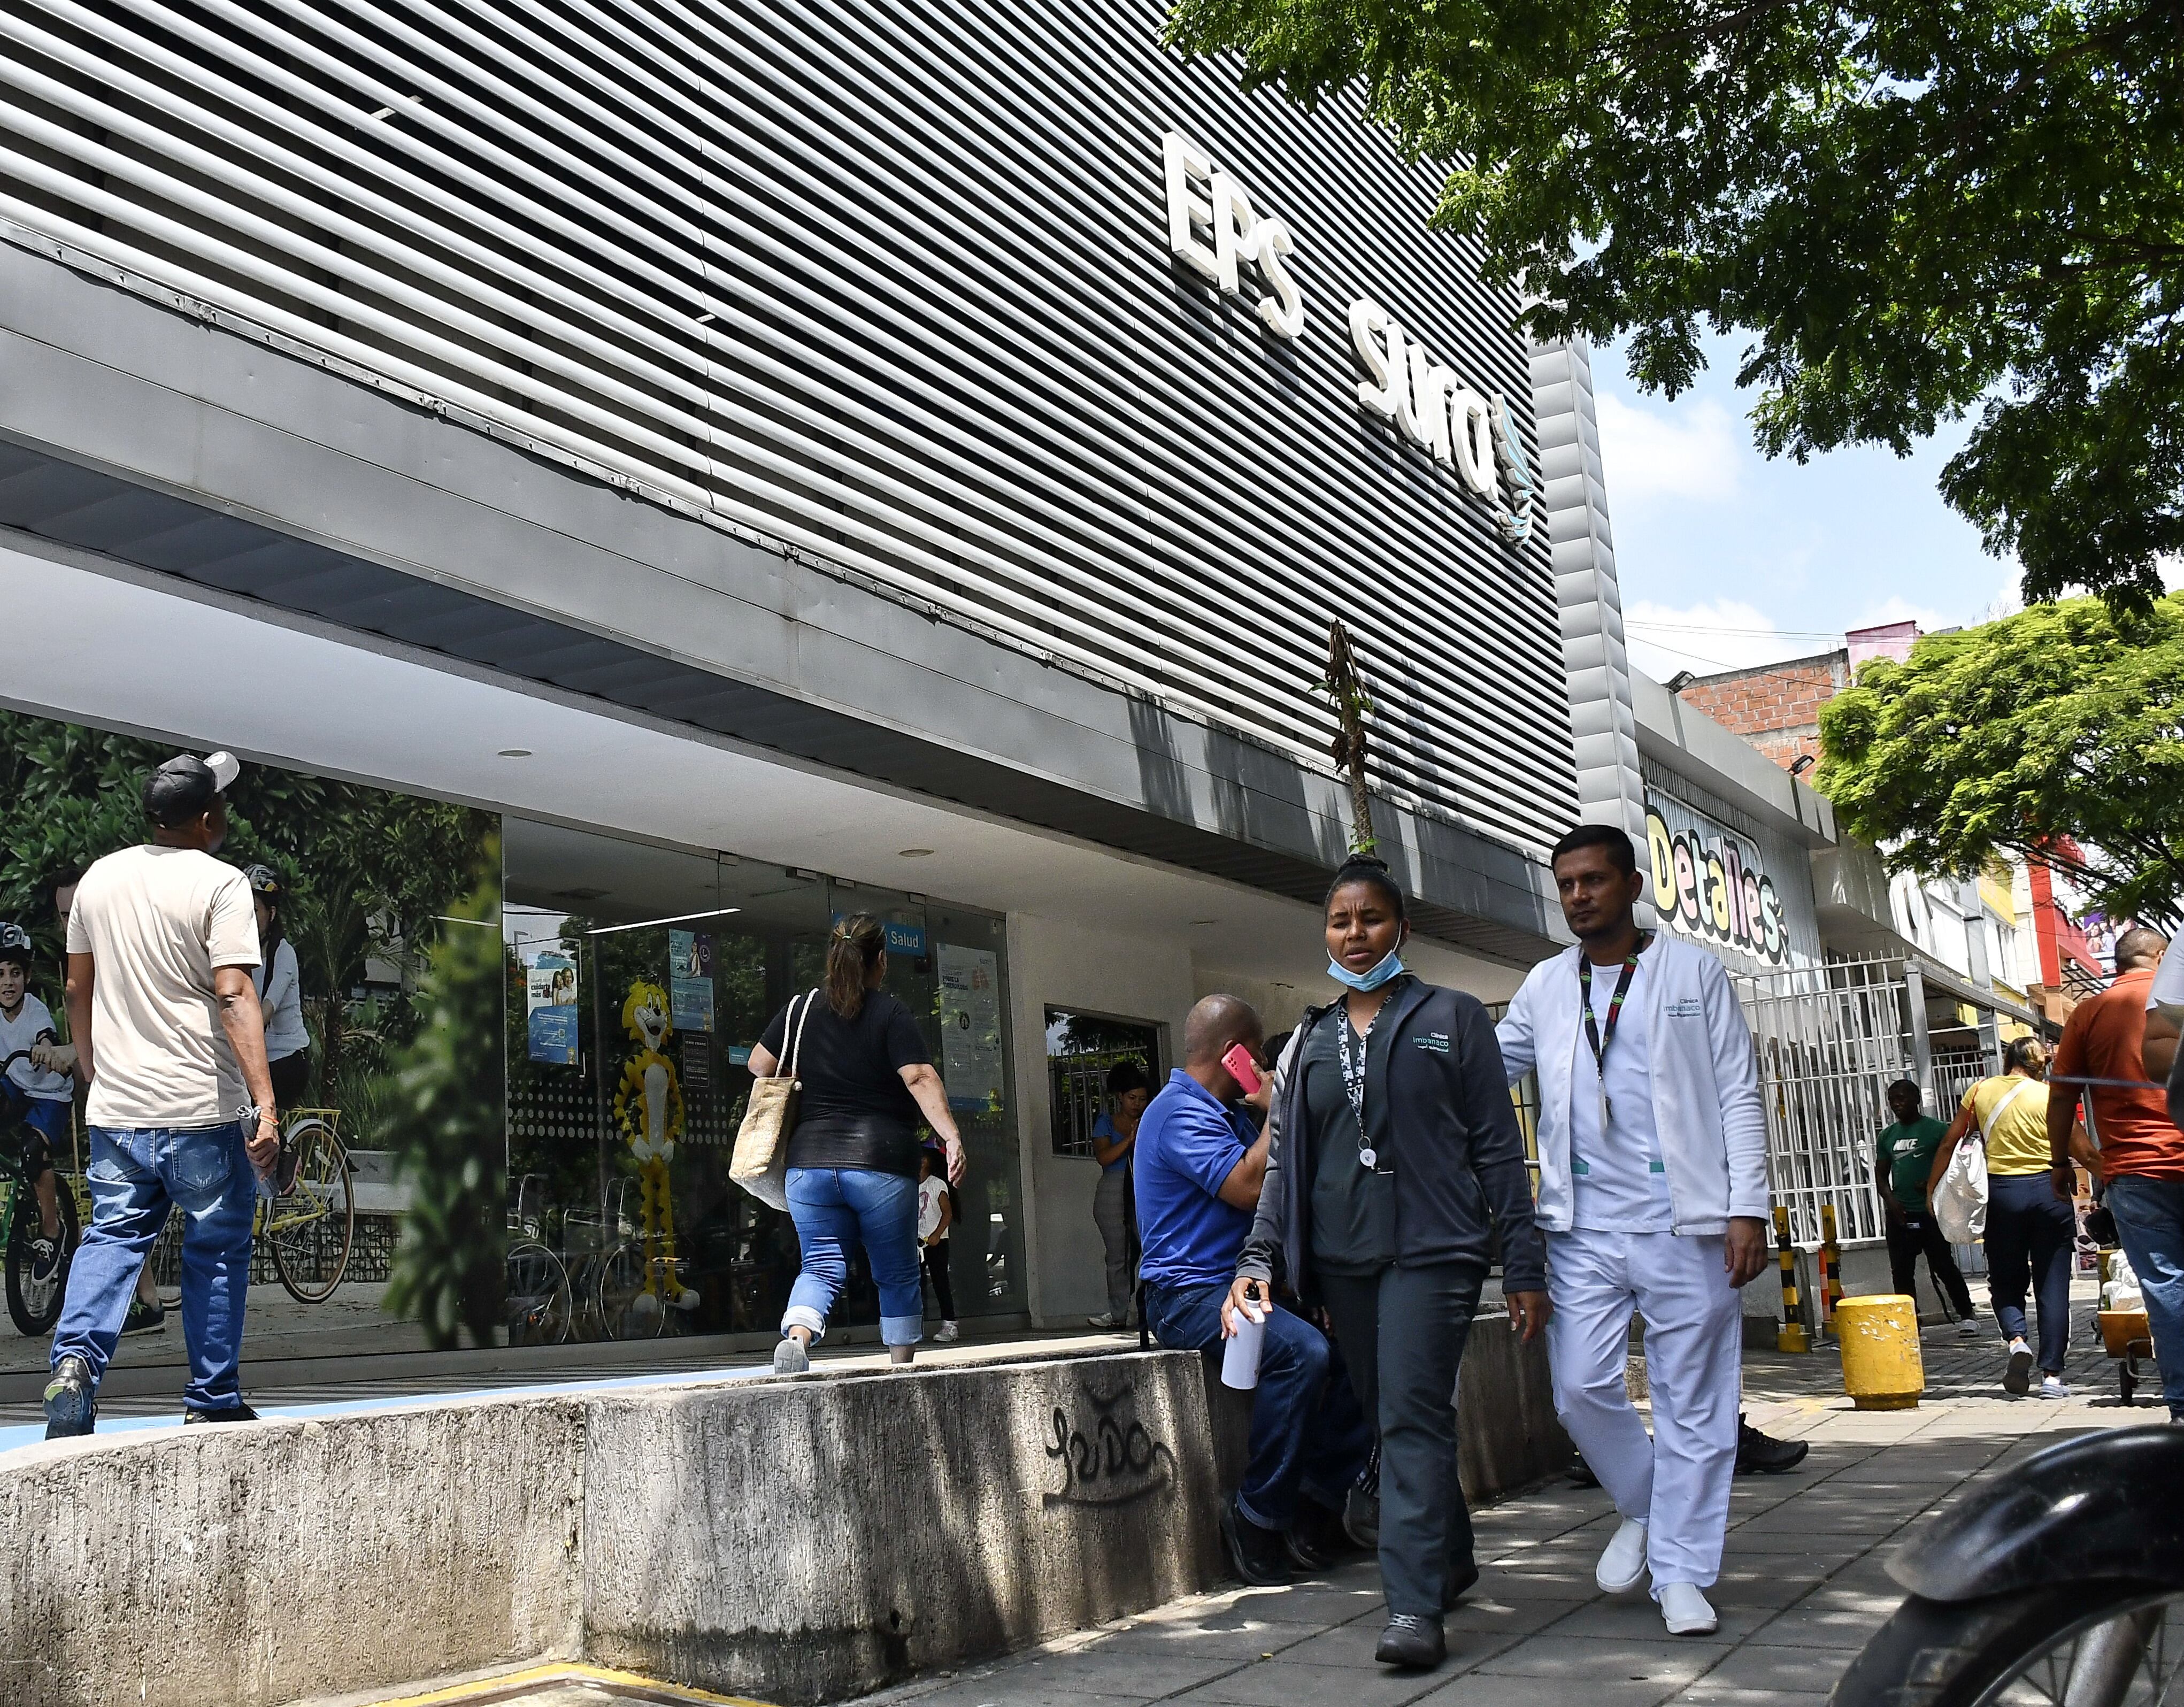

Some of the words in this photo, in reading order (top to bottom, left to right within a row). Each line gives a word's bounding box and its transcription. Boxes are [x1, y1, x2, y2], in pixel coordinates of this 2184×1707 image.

[1163, 131, 1304, 338] EPS
[1645, 805, 1783, 965] Detalles
[891, 931, 919, 948] Salud
[1412, 1036, 1449, 1047] Imbanaco
[1893, 1138, 1918, 1151] NIKE
